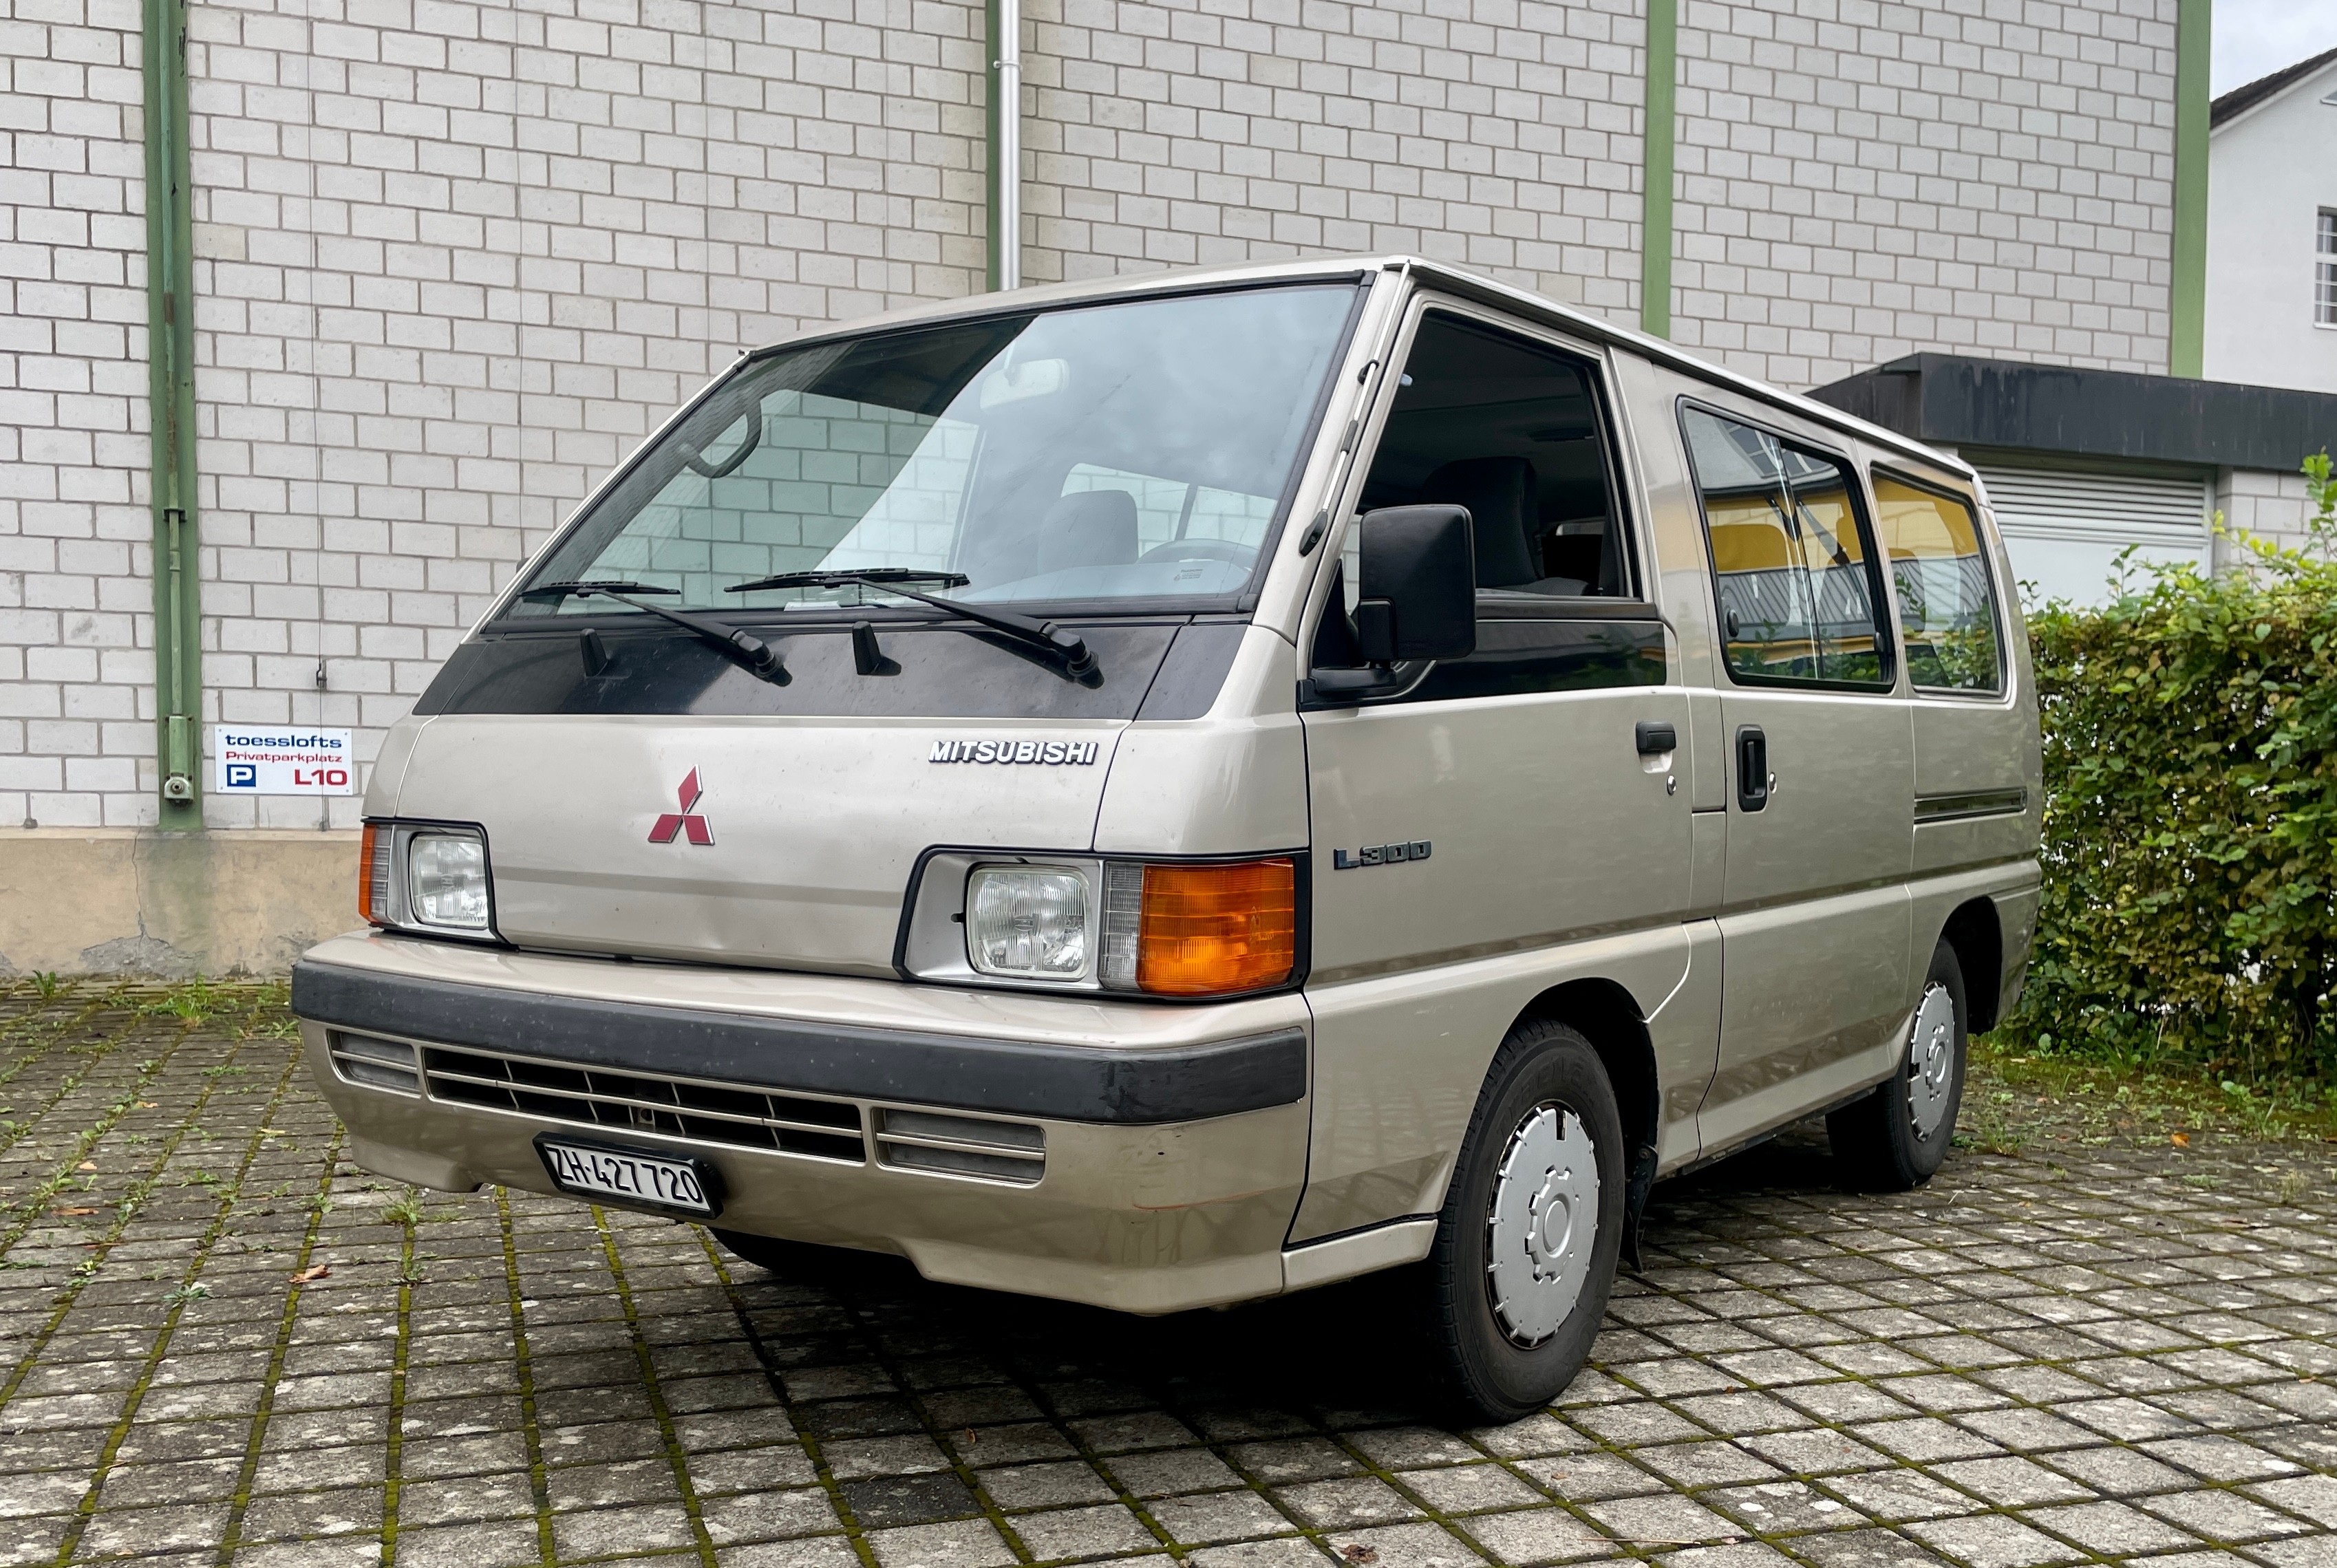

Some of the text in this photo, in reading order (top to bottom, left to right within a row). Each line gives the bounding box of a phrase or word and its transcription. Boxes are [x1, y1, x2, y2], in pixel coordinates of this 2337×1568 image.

[225, 734, 342, 749] toesslofts
[225, 751, 343, 764] Privatparkplatz
[928, 740, 1099, 765] MITSUBISHI
[230, 766, 348, 786] P L10
[1333, 839, 1432, 870] L300
